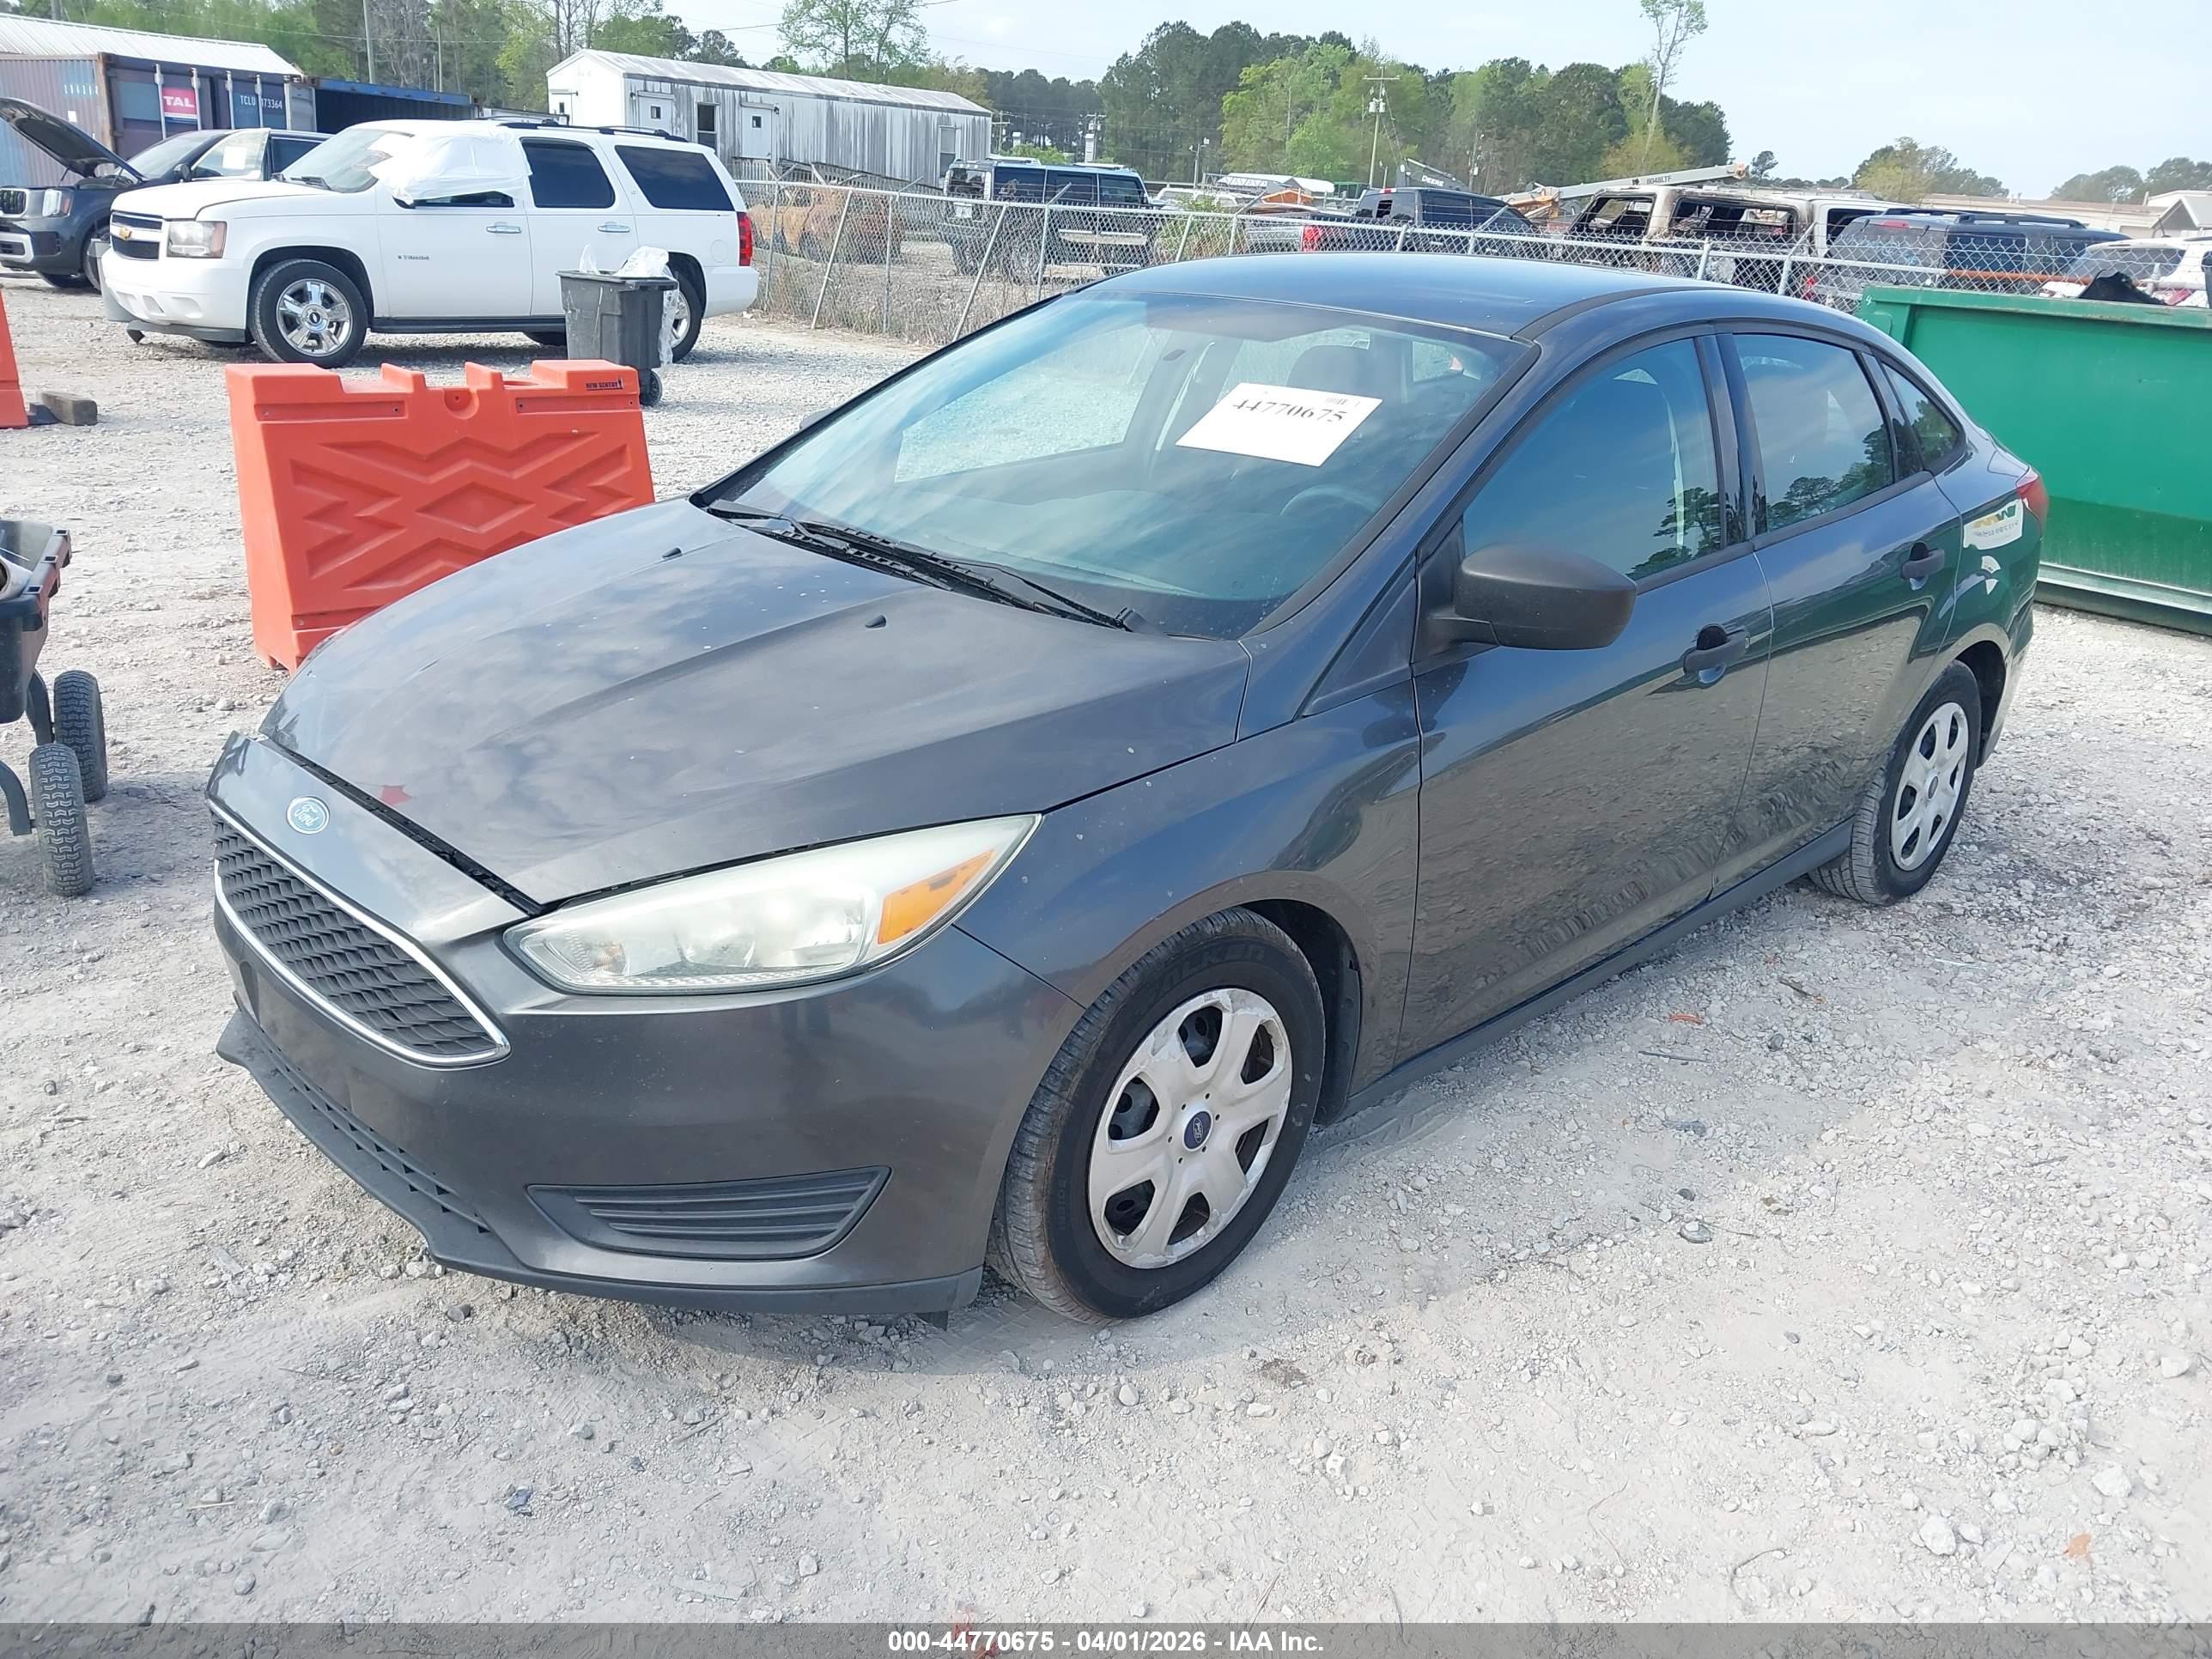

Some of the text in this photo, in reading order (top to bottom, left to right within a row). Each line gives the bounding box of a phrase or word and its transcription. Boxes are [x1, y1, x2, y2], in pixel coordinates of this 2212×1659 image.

[163, 96, 195, 108] TAL
[240, 95, 256, 106] TCLU
[1421, 174, 1444, 187] DEERE
[1232, 398, 1347, 422] 44770675
